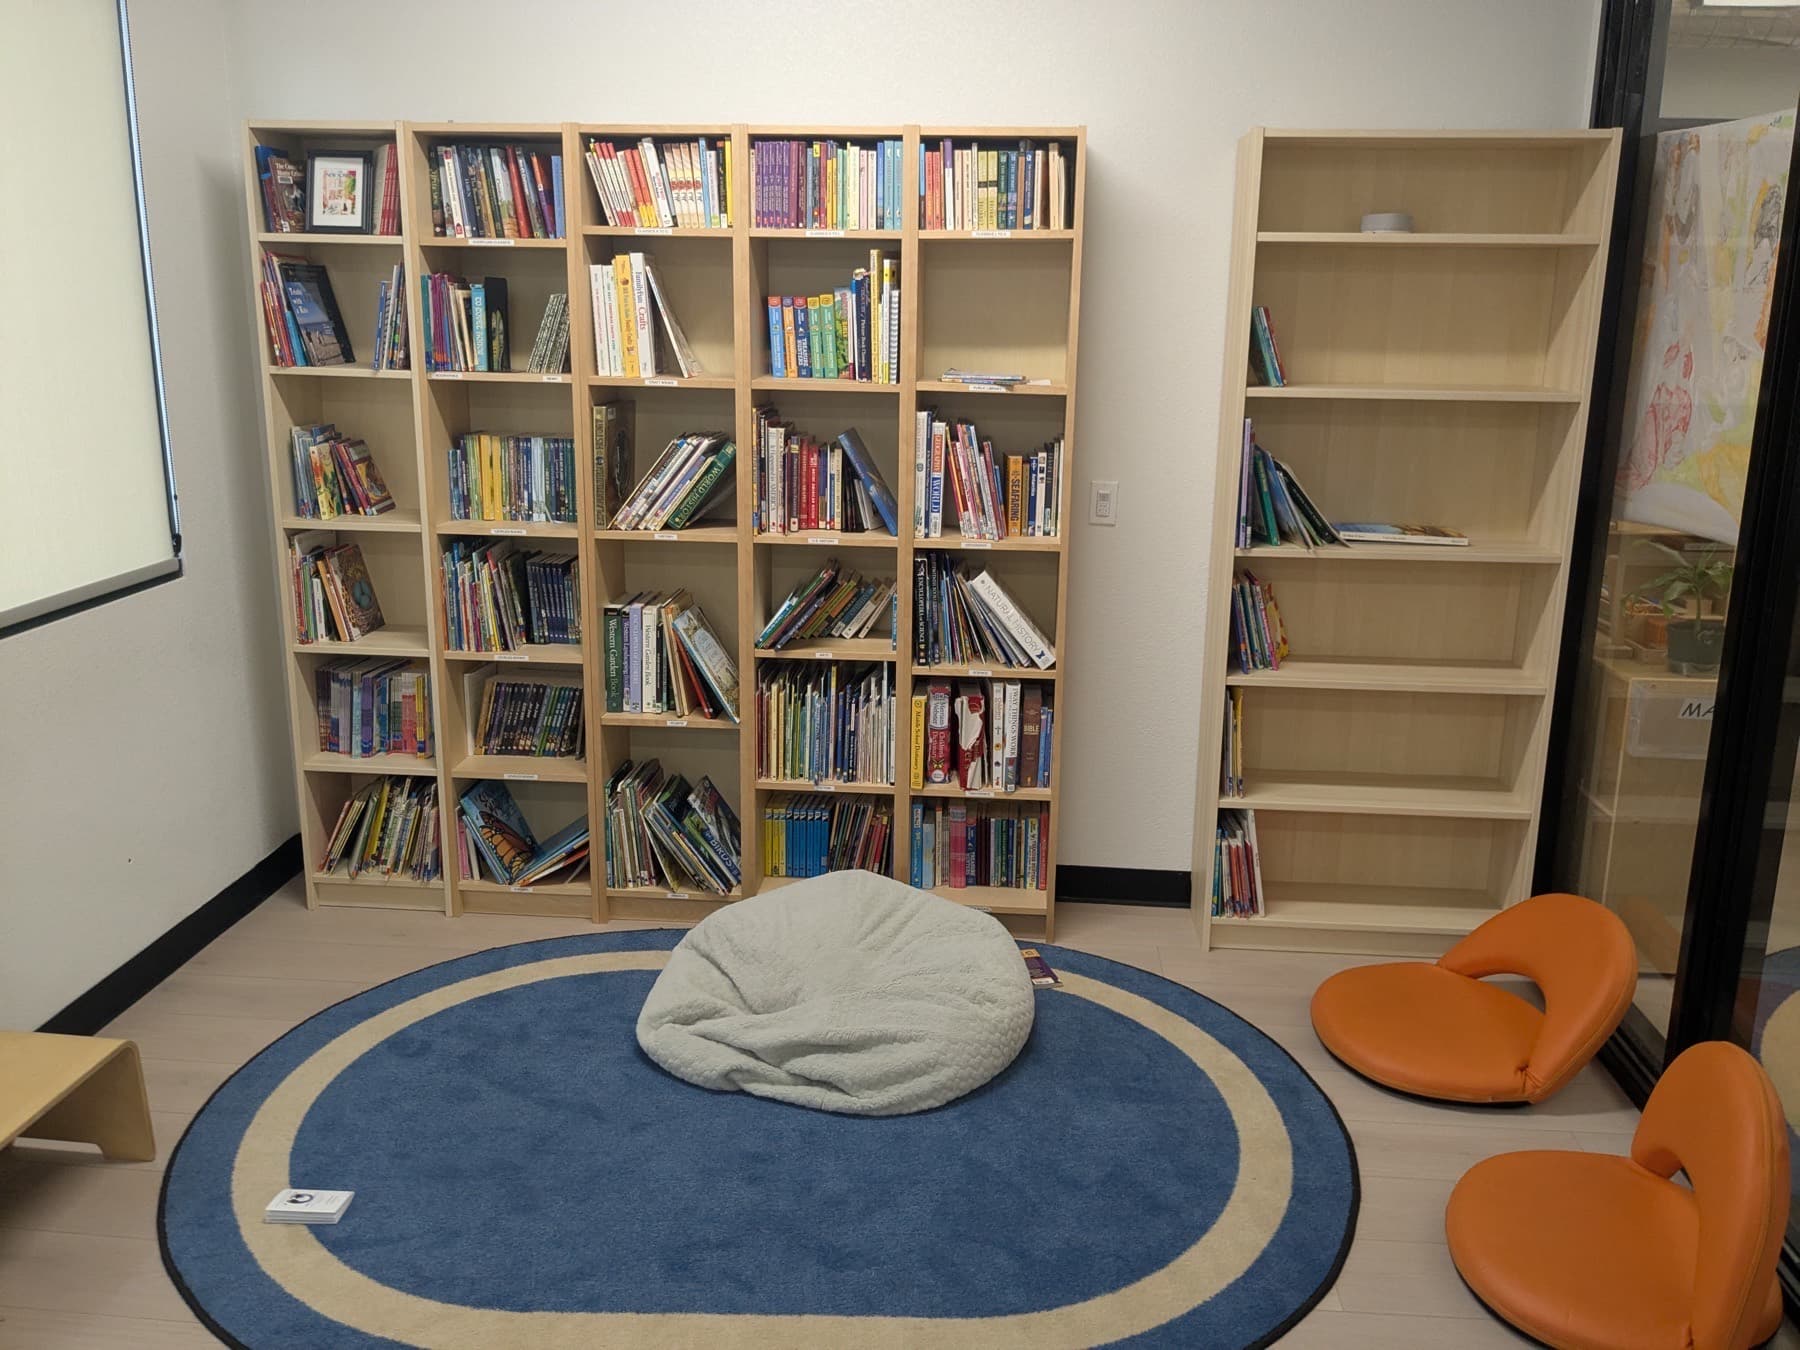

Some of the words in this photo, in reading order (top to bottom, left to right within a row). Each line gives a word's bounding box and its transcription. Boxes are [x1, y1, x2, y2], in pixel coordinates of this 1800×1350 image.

[638, 307, 647, 330] Crafts
[933, 435, 942, 472] GEOGRAPHY
[698, 467, 721, 493] WORLD
[677, 493, 699, 522] HISTORY
[931, 478, 940, 512] WORLD
[1010, 478, 1020, 521] SEAFARING
[984, 584, 1014, 622] NATURAL
[1013, 617, 1041, 652] HISTORY
[608, 619, 617, 648] Western
[610, 649, 618, 677] Garden
[610, 678, 619, 697] Book
[710, 838, 732, 866] BIRDS
